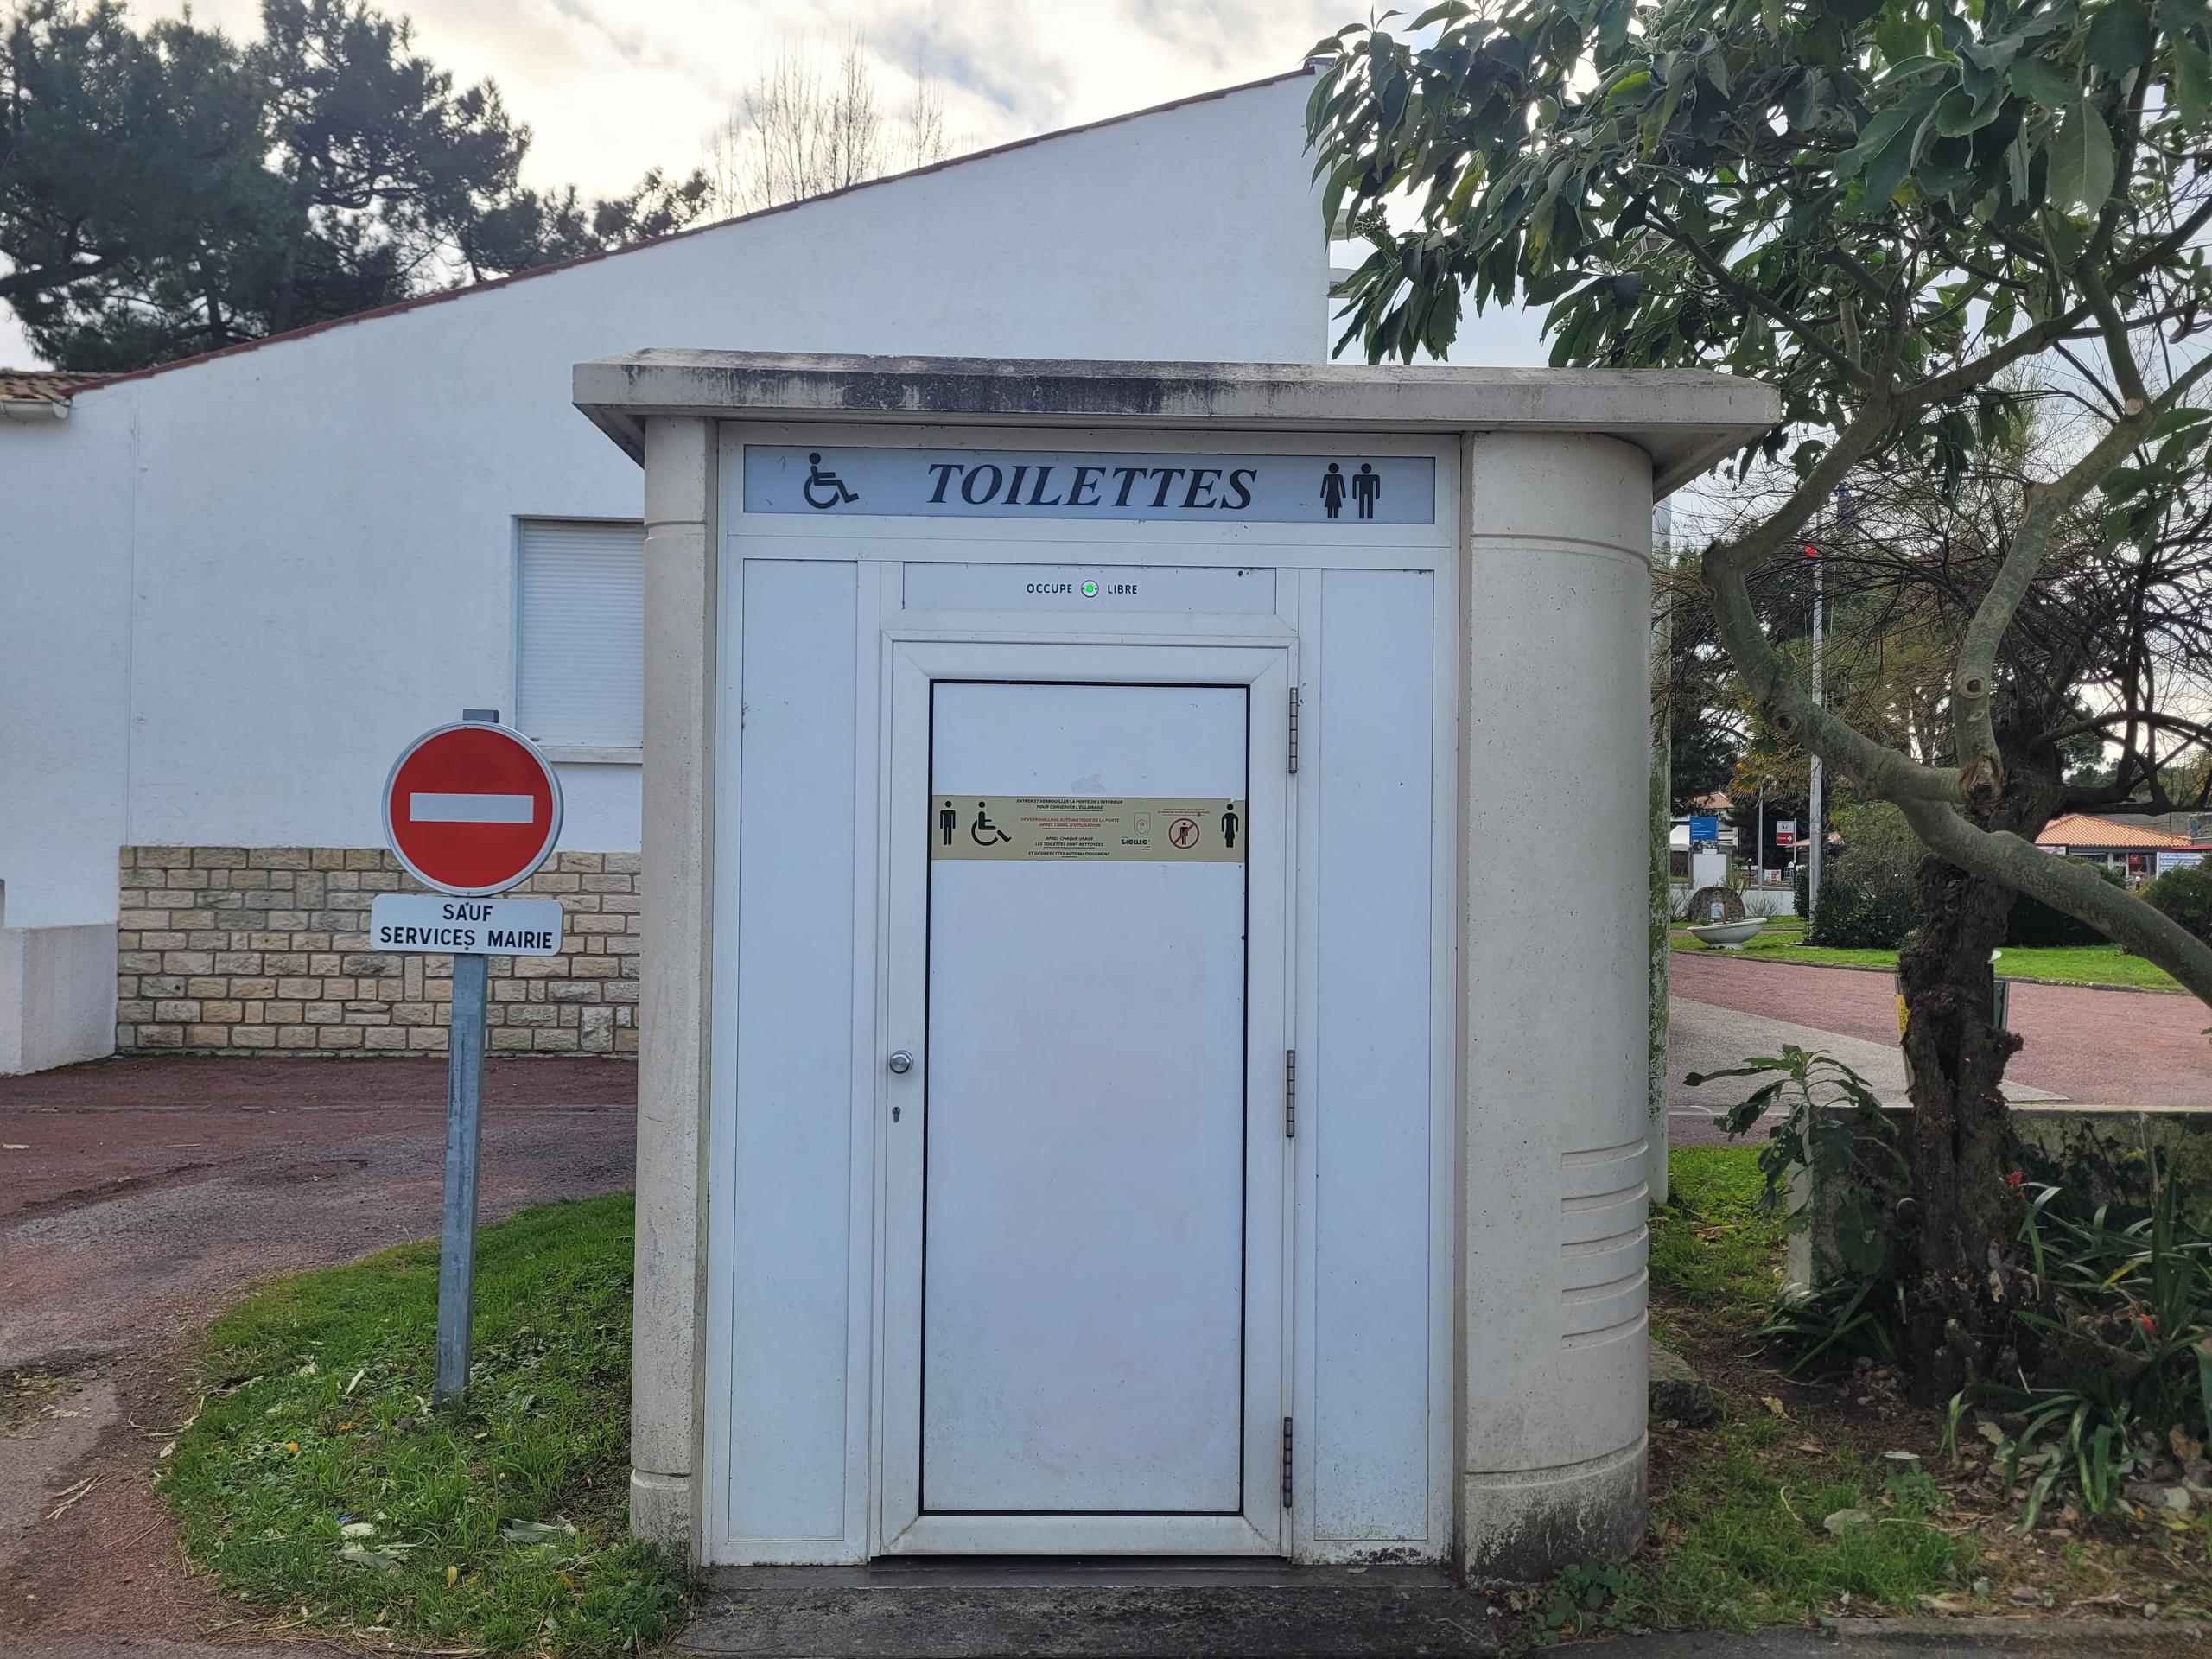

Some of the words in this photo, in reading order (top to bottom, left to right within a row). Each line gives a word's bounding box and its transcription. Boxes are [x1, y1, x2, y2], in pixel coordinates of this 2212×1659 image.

[925, 463, 1258, 510] TOILETTES
[1026, 583, 1073, 594] OCCUPE
[1107, 584, 1138, 594] LIBRE
[442, 903, 493, 922] SAUF
[379, 926, 475, 946] SERVICES
[487, 930, 553, 949] MAIRIE
